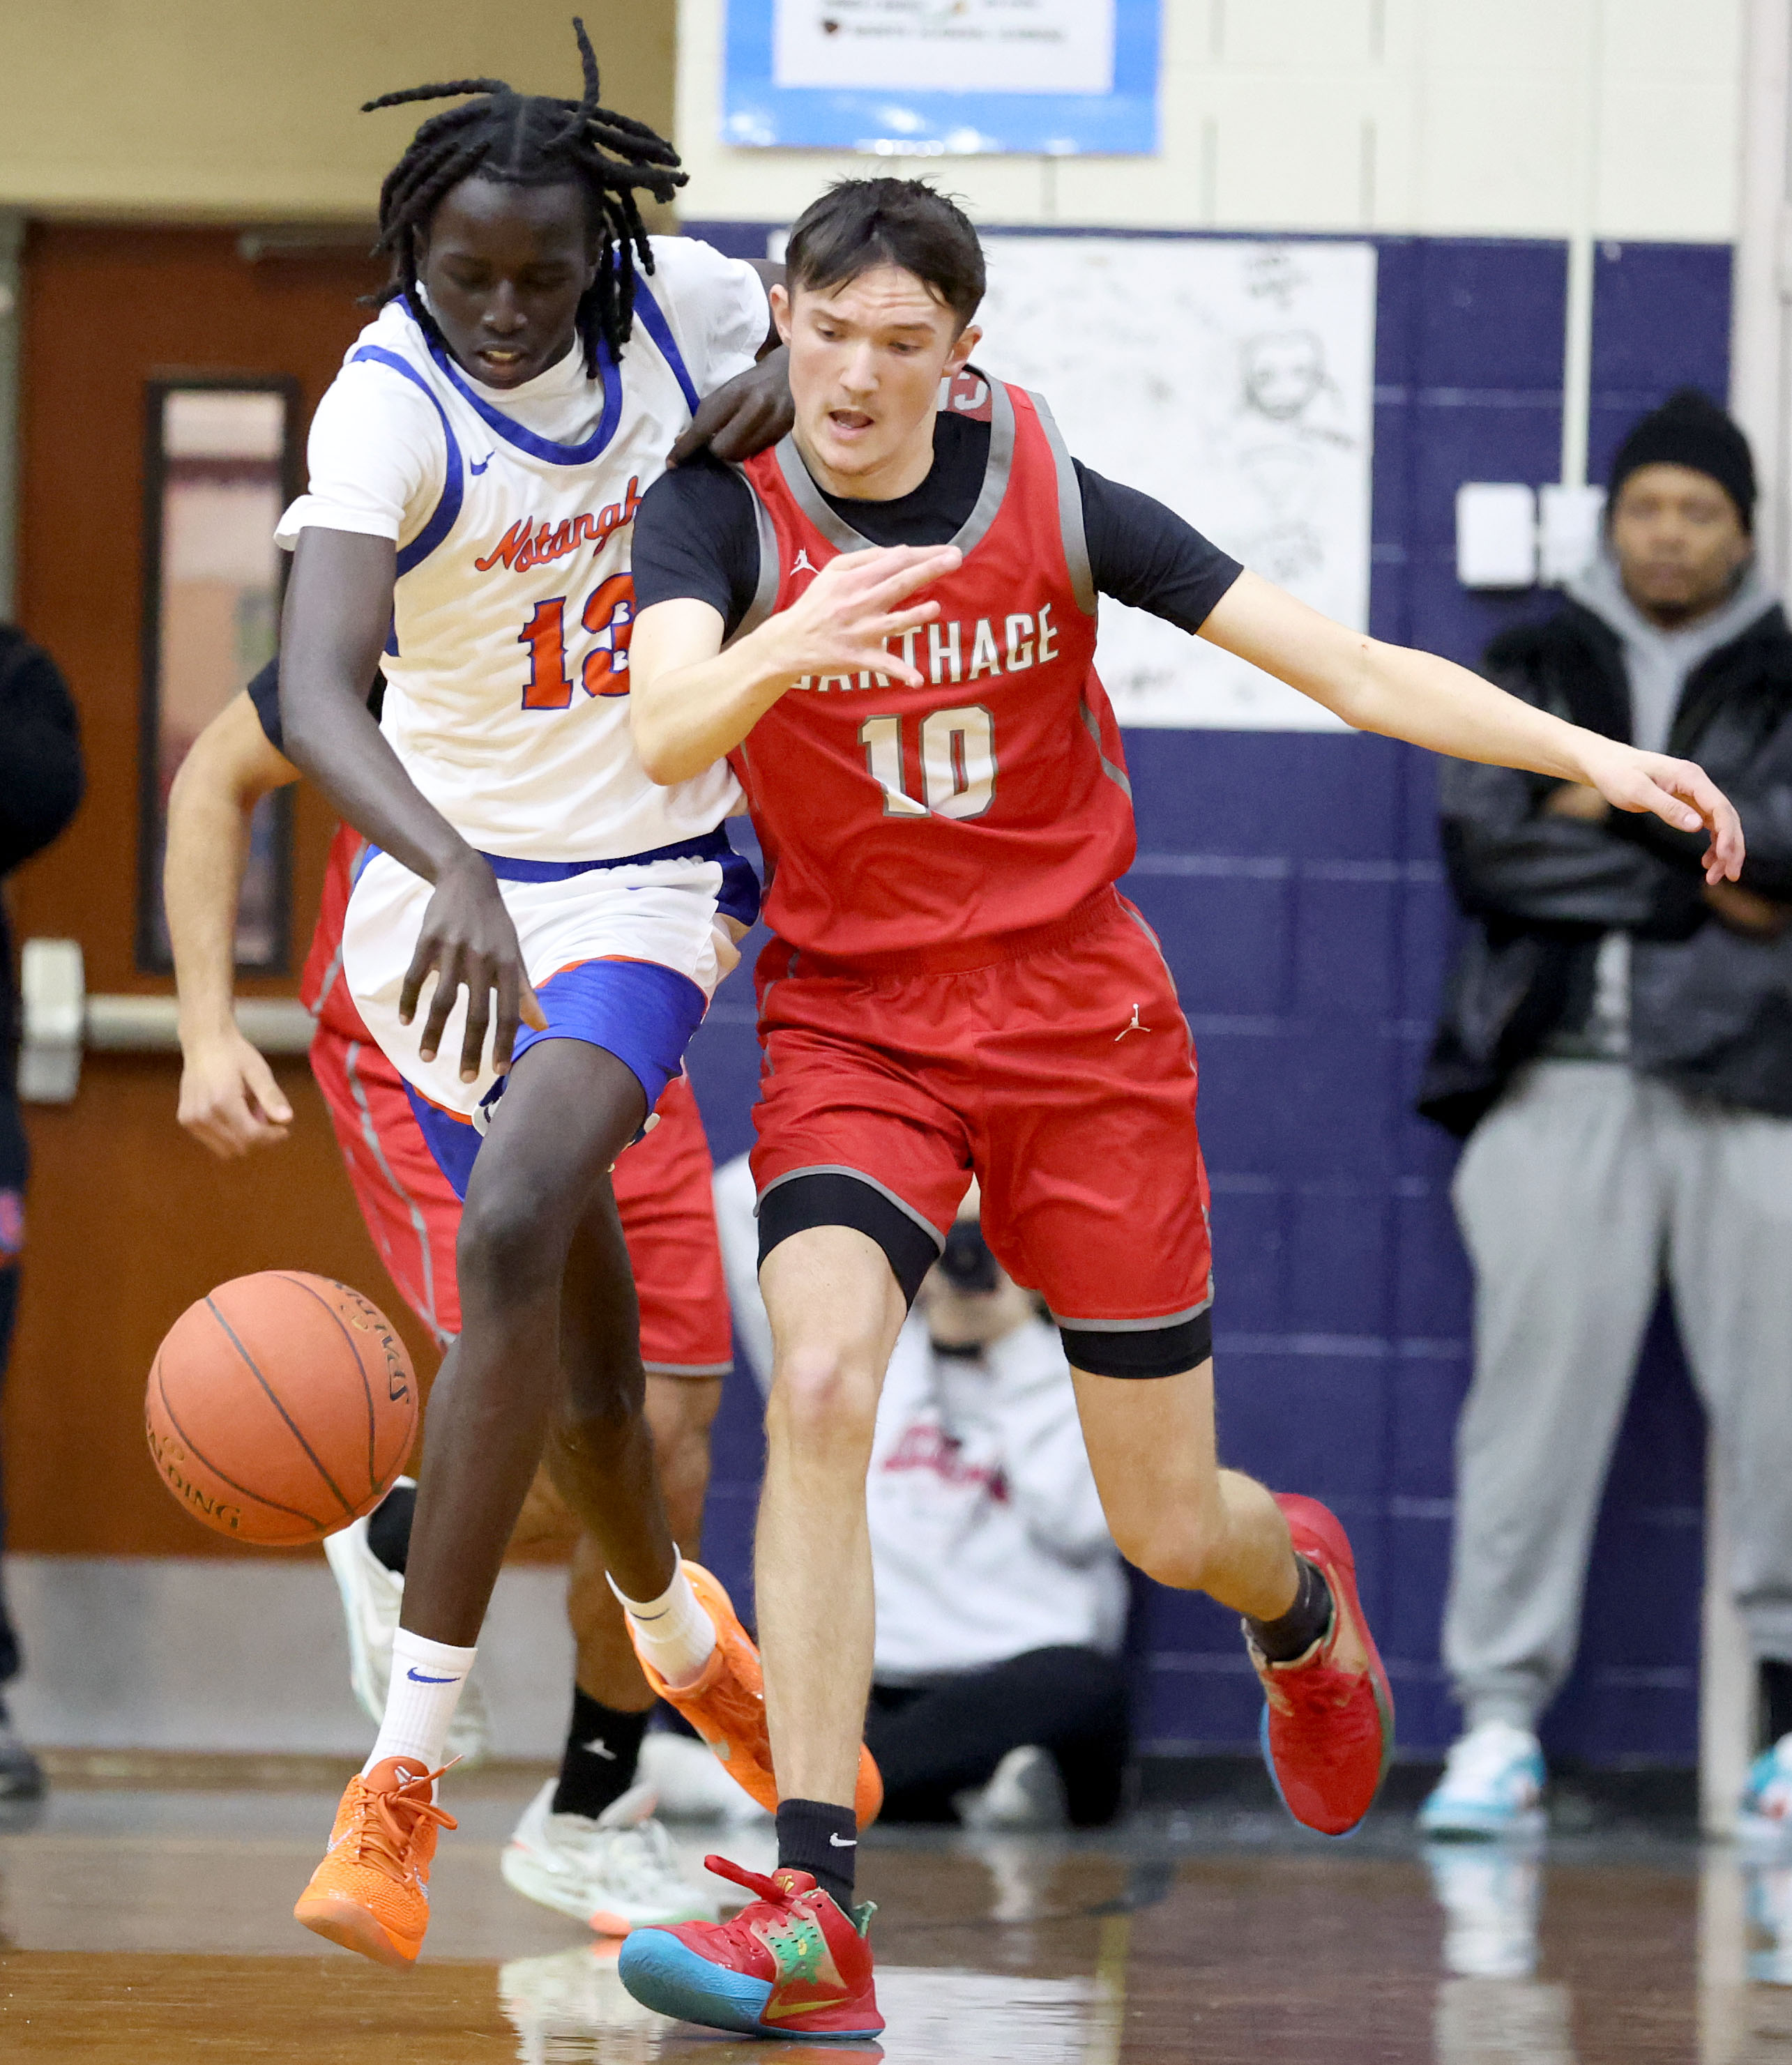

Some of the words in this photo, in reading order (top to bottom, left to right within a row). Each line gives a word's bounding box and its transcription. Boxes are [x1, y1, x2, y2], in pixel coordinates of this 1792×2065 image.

[517, 572, 636, 710] 13
[788, 602, 1060, 692] THAGE
[857, 703, 998, 821] 10
